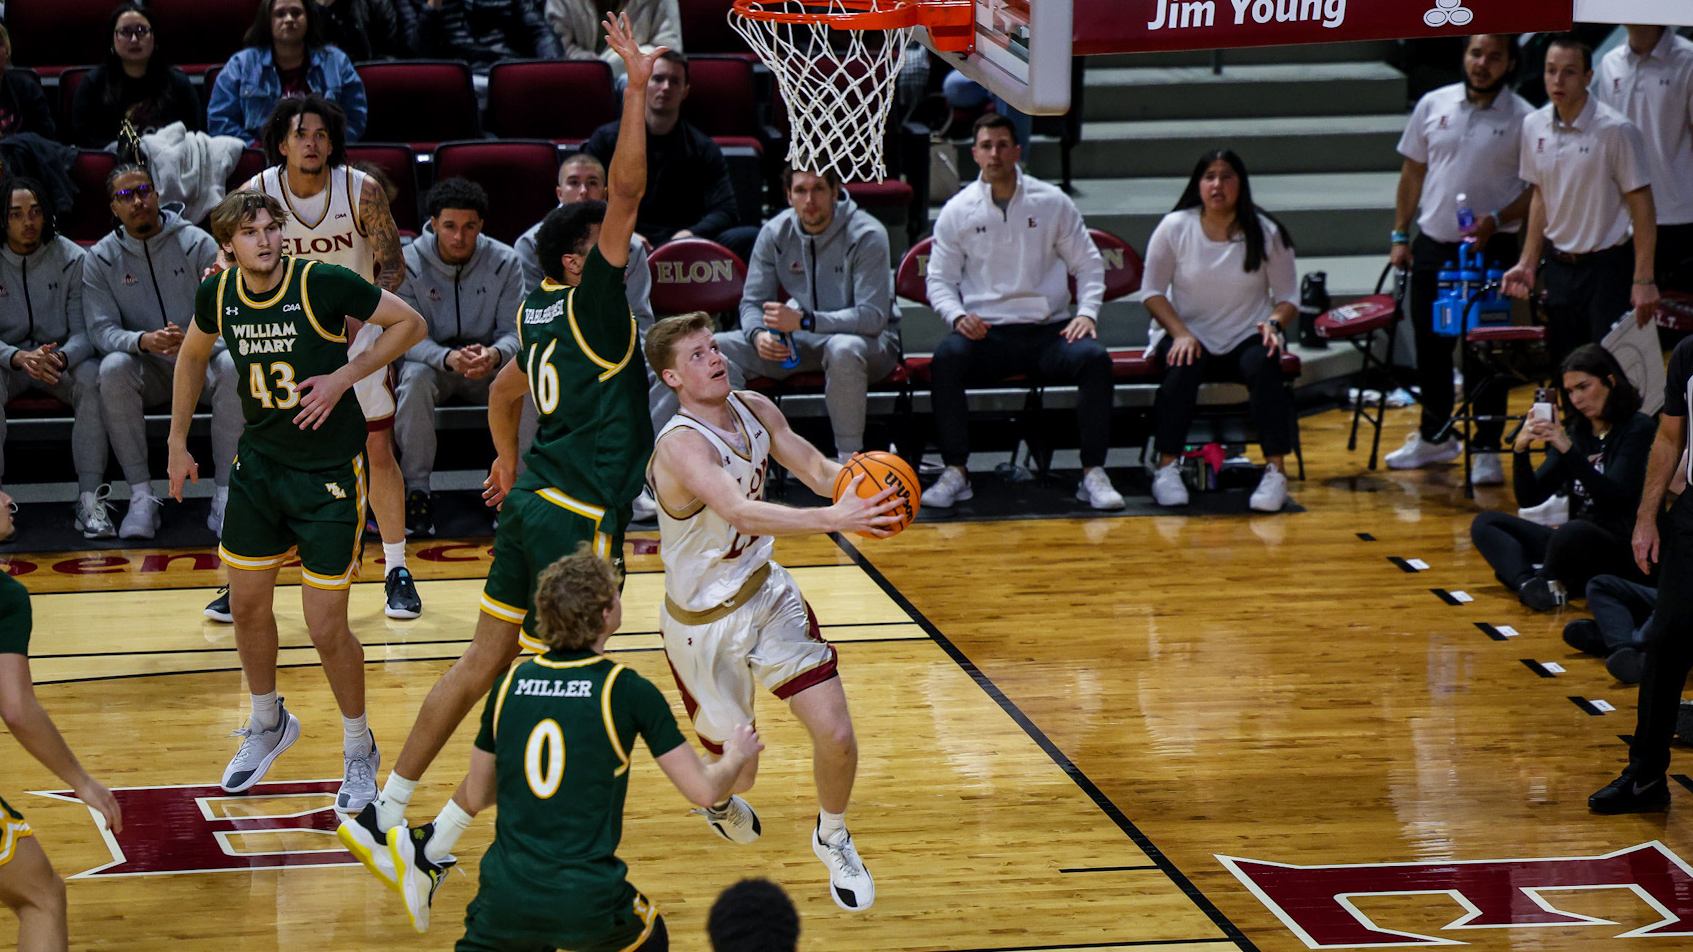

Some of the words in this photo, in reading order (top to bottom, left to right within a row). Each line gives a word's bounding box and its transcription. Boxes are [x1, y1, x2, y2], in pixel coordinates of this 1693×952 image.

[1147, 0, 1216, 31] Jim
[1230, 0, 1347, 29] Young
[655, 259, 734, 284] ELON
[282, 303, 301, 312] CAA
[230, 321, 298, 339] WILLIAM
[249, 361, 301, 410] 43
[527, 337, 560, 415] 16
[514, 679, 593, 697] MILLER
[524, 718, 566, 799] 0
